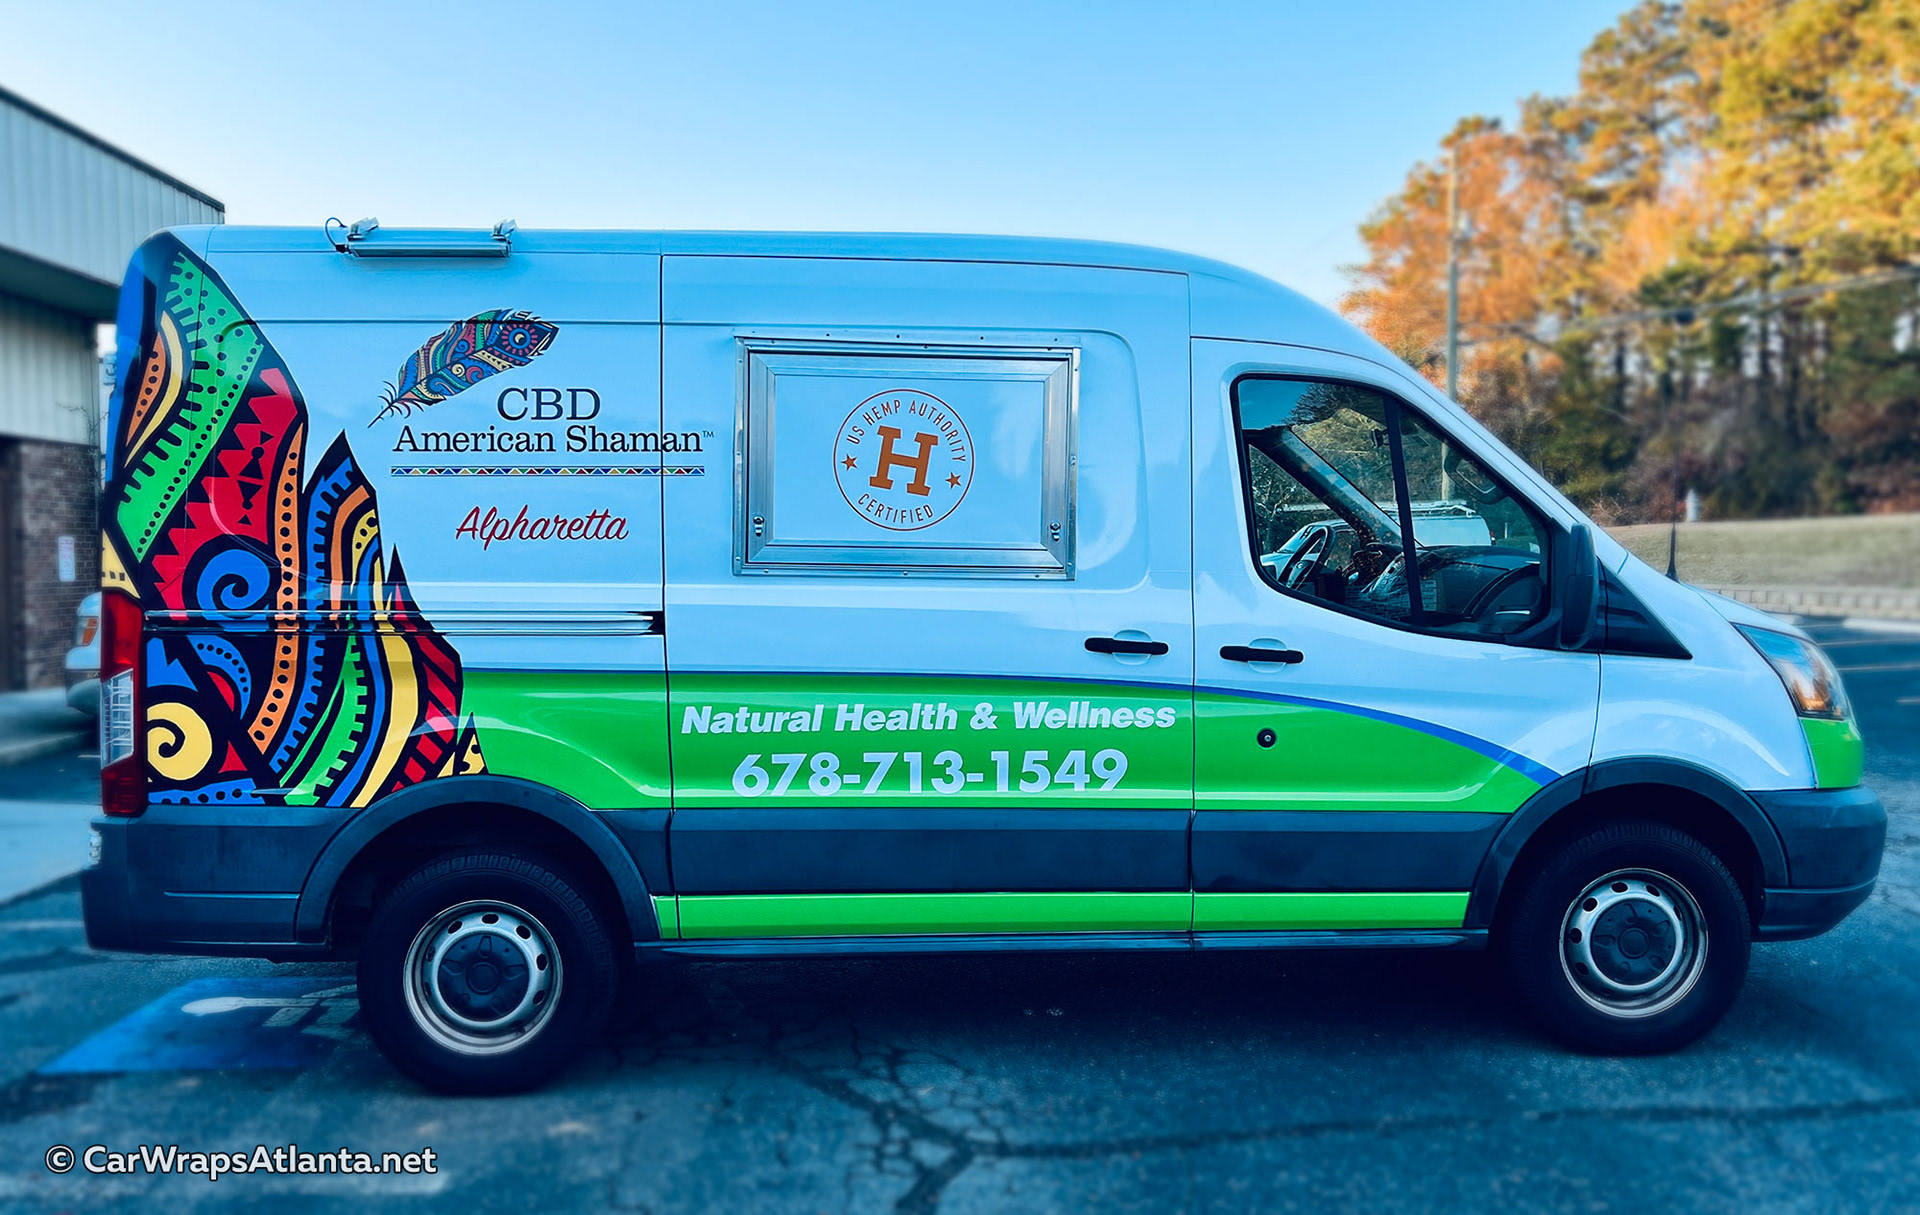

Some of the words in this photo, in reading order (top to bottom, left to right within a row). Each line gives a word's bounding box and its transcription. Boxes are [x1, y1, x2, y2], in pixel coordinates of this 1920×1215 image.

[497, 387, 601, 421] CBD
[392, 425, 556, 453] American
[846, 425, 865, 445] US
[862, 399, 900, 426] HEMP
[909, 400, 966, 463] AUTHORITY
[869, 425, 939, 497] H
[455, 504, 630, 551] Alpharetta
[858, 493, 934, 524] CERTIFIED
[681, 704, 824, 734] Natural
[834, 702, 958, 732] Health
[969, 703, 998, 730] &
[1013, 701, 1177, 729] Wellness
[731, 748, 1129, 797] 678-713-1549
